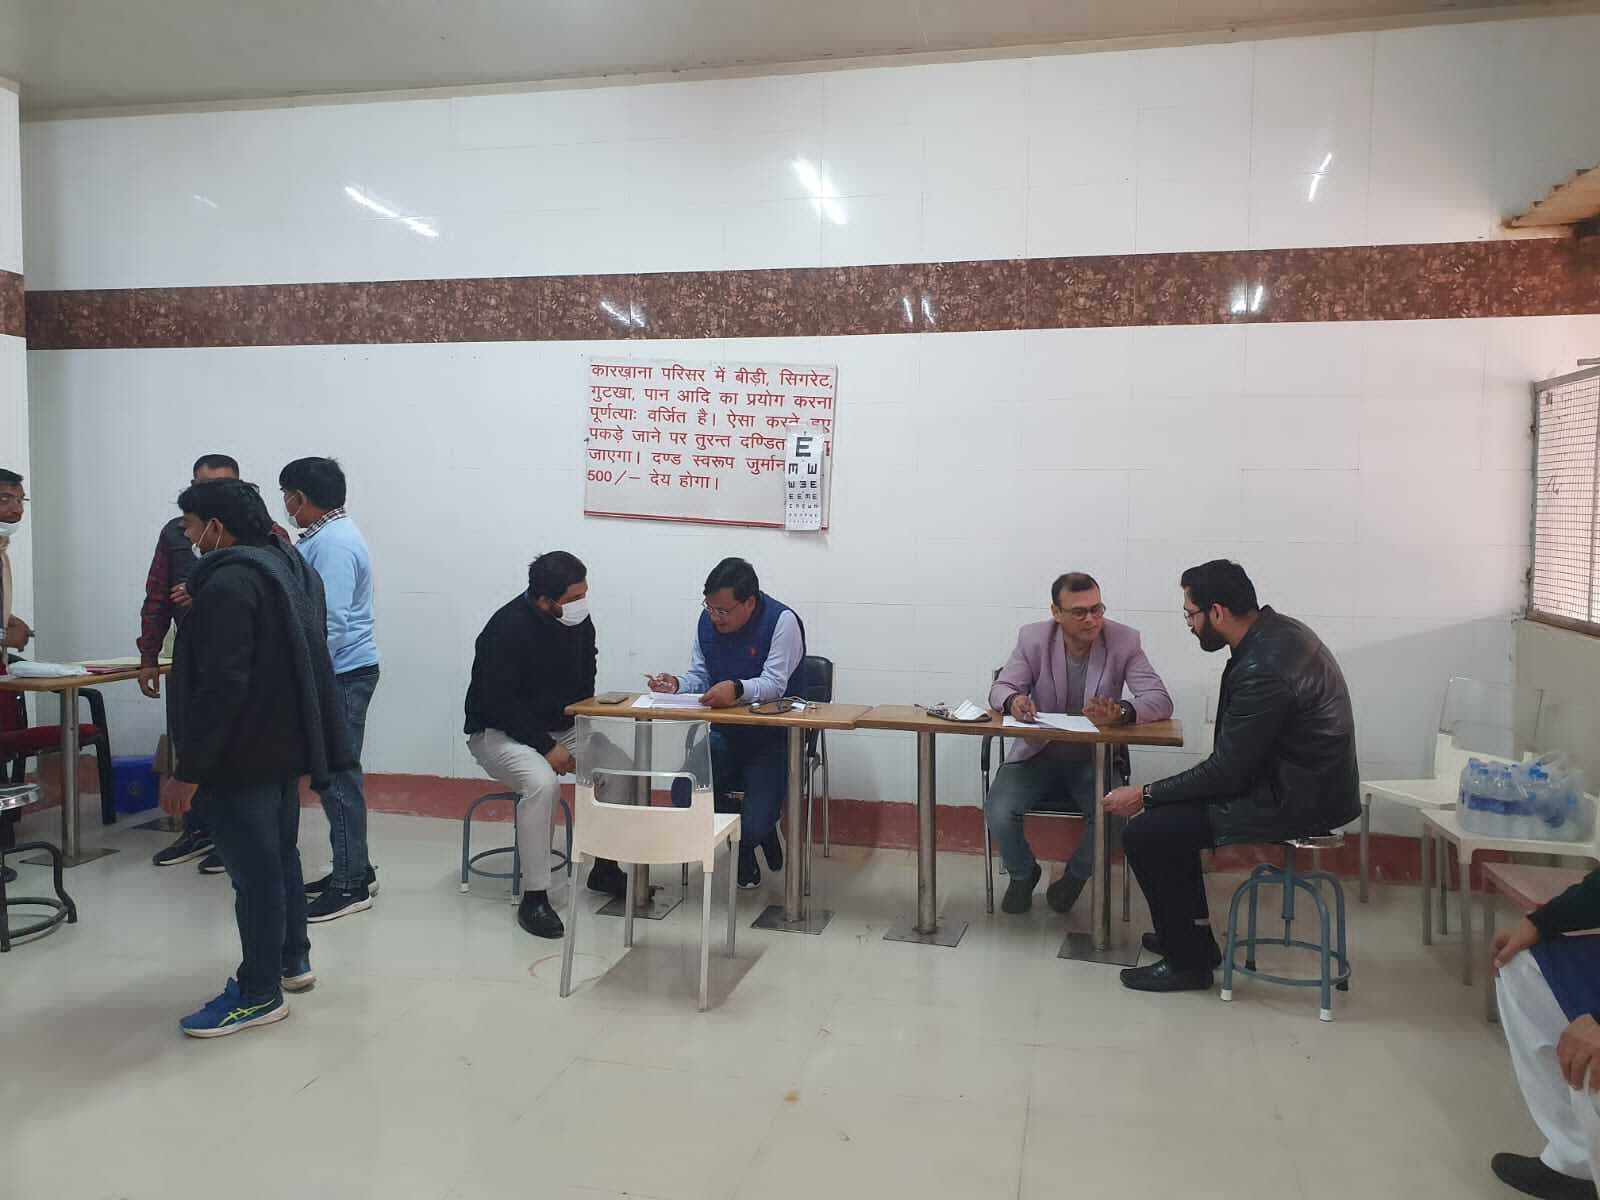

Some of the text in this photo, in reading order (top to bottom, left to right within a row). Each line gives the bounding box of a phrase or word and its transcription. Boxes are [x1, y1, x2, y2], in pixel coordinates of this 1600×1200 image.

[661, 364, 705, 381] परिसर
[714, 365, 726, 383] में
[644, 388, 670, 402] पान
[677, 386, 712, 404] आदि
[719, 391, 739, 406] का
[746, 389, 785, 408] प्रयोग
[793, 395, 832, 410] करना
[647, 406, 688, 424] वर्जित
[727, 409, 756, 429] ऐसा
[589, 425, 787, 451] पकड़े जाने पर तुरन्त दण्डित
[796, 436, 813, 457] E
[651, 452, 682, 465] दण्ड
[691, 453, 737, 469] स्वरूप
[648, 468, 672, 487] देय
